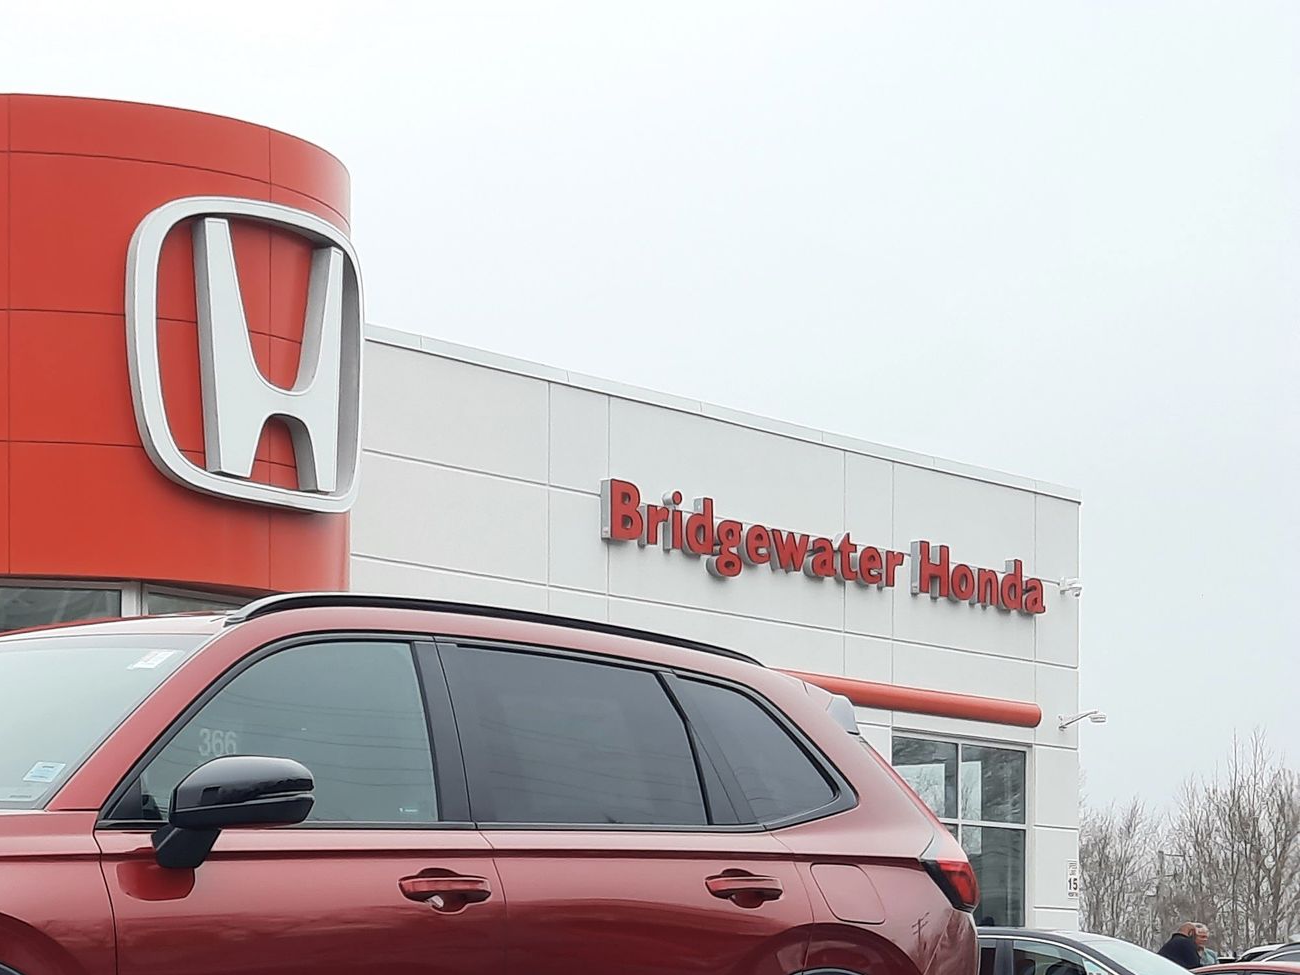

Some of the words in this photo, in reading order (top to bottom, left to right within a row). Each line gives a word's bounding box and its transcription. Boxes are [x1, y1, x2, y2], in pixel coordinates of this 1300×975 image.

[608, 478, 905, 588] Bridgewater
[917, 540, 1046, 613] Honda
[198, 728, 237, 757] 366
[1068, 878, 1078, 891] 15
